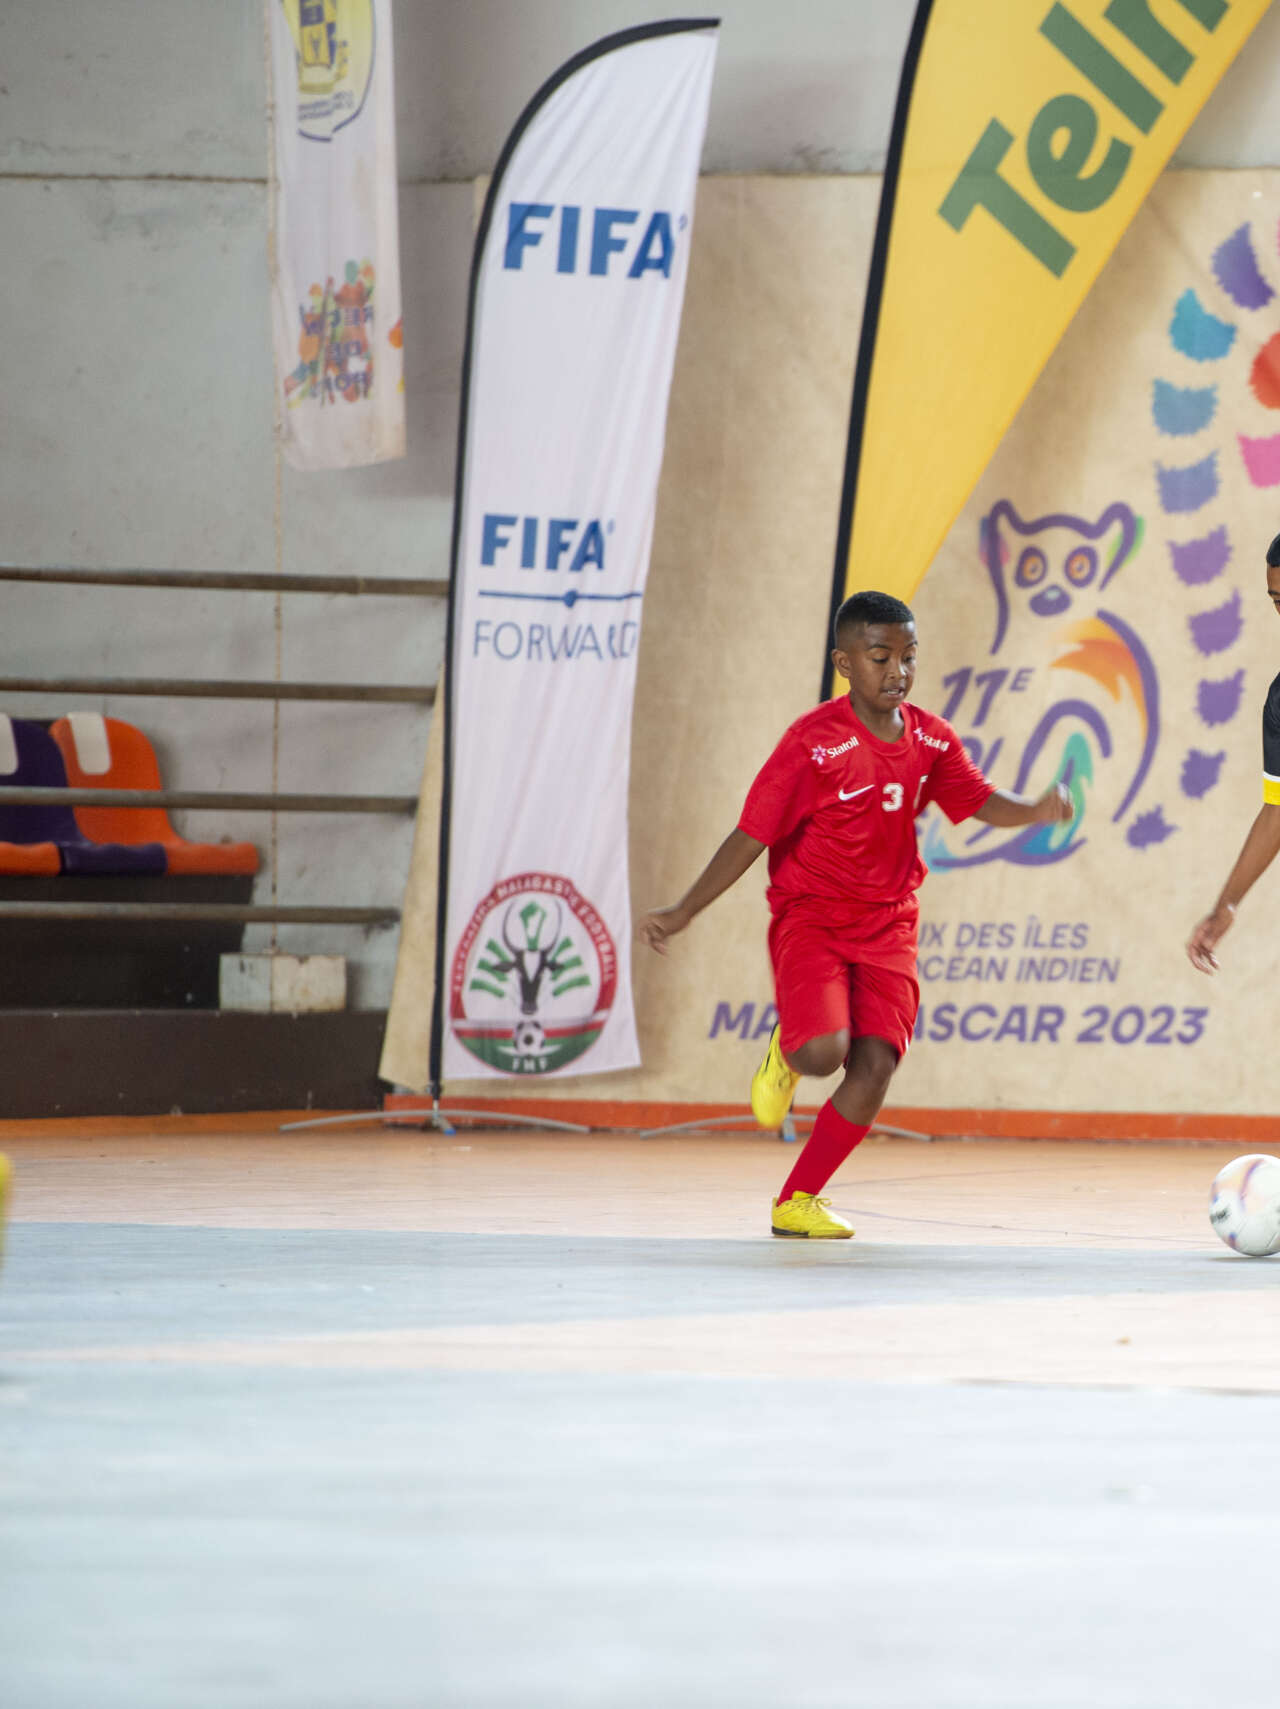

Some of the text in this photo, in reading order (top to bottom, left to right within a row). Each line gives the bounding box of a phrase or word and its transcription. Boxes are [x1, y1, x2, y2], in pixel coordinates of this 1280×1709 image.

[827, 735, 859, 759] Statoil
[881, 782, 904, 812] 3
[955, 922, 1016, 949] DES
[1023, 914, 1090, 949] ÎLES
[1015, 956, 1121, 983] INDIEN
[1075, 1004, 1208, 1046] 2023
